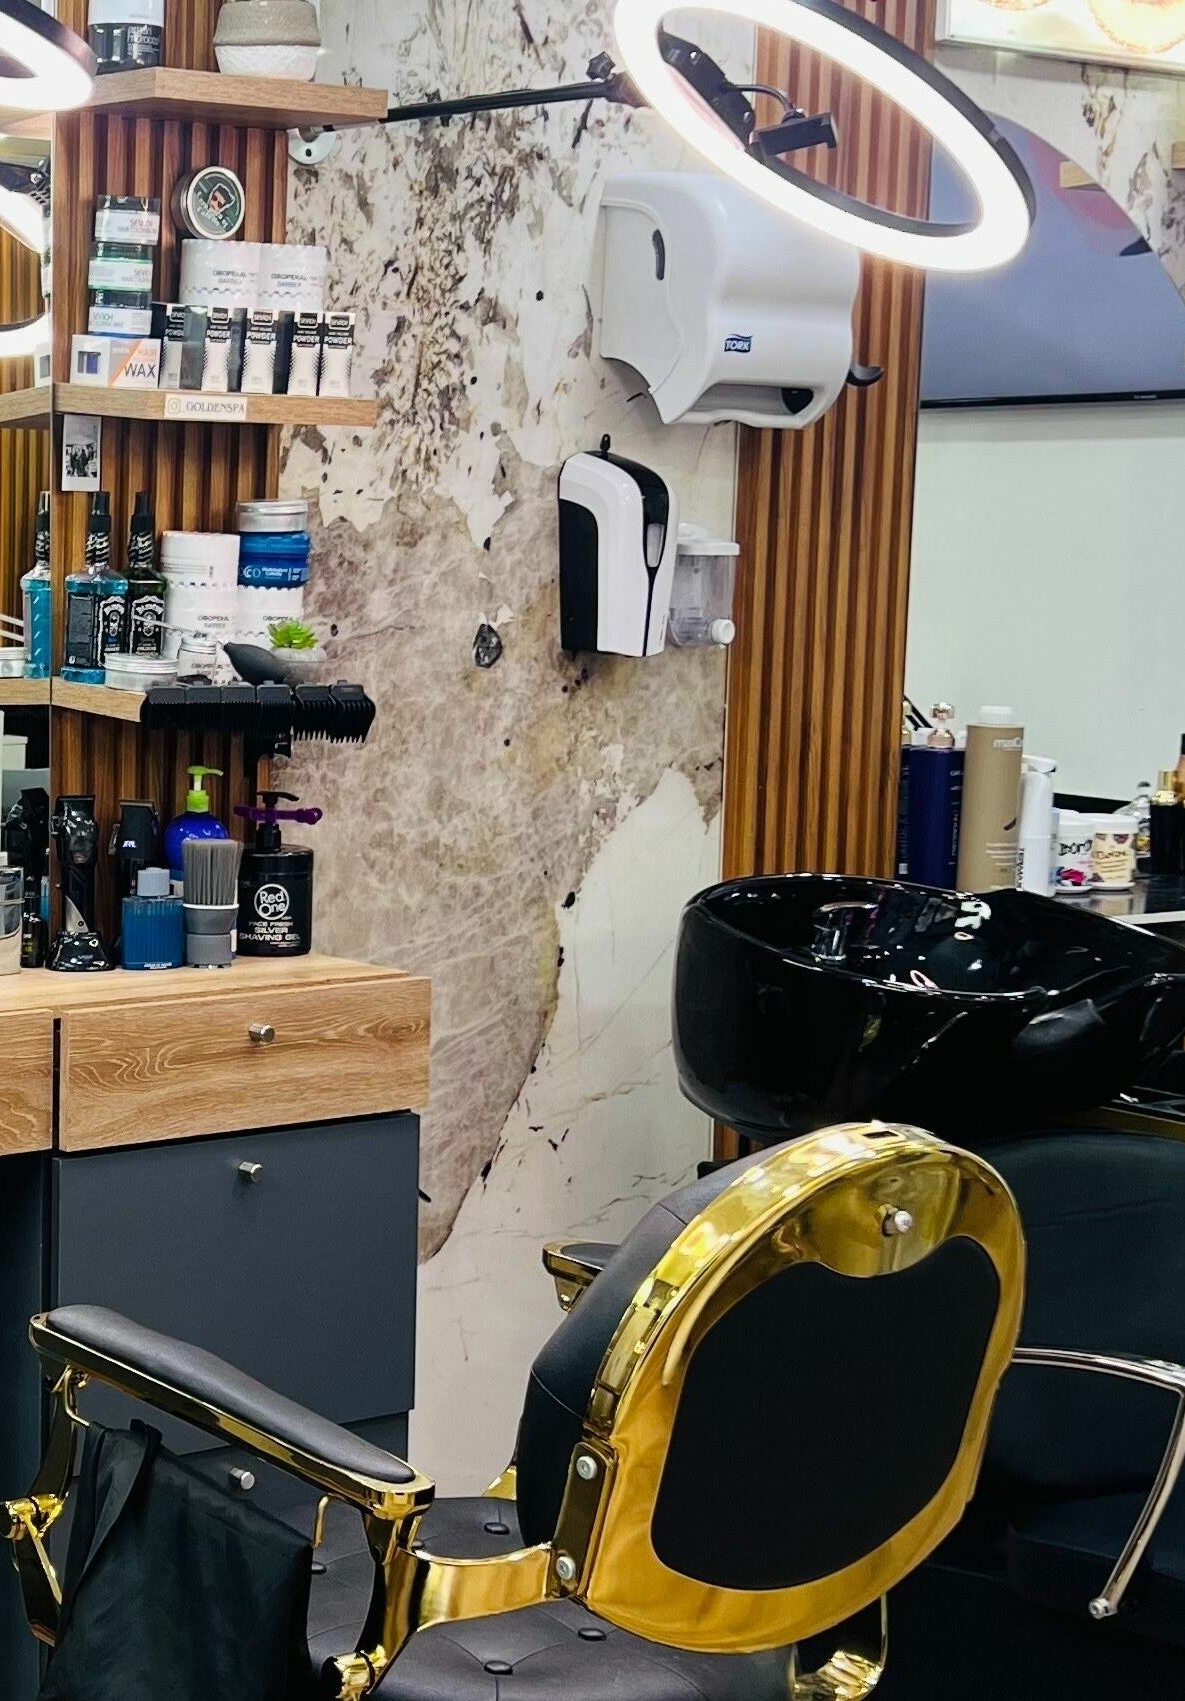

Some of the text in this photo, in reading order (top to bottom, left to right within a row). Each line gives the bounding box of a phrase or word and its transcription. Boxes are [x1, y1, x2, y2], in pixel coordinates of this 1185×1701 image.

[726, 340, 749, 350] TORK
[124, 363, 156, 378] WAX
[259, 890, 285, 904] Red
[259, 902, 285, 917] One
